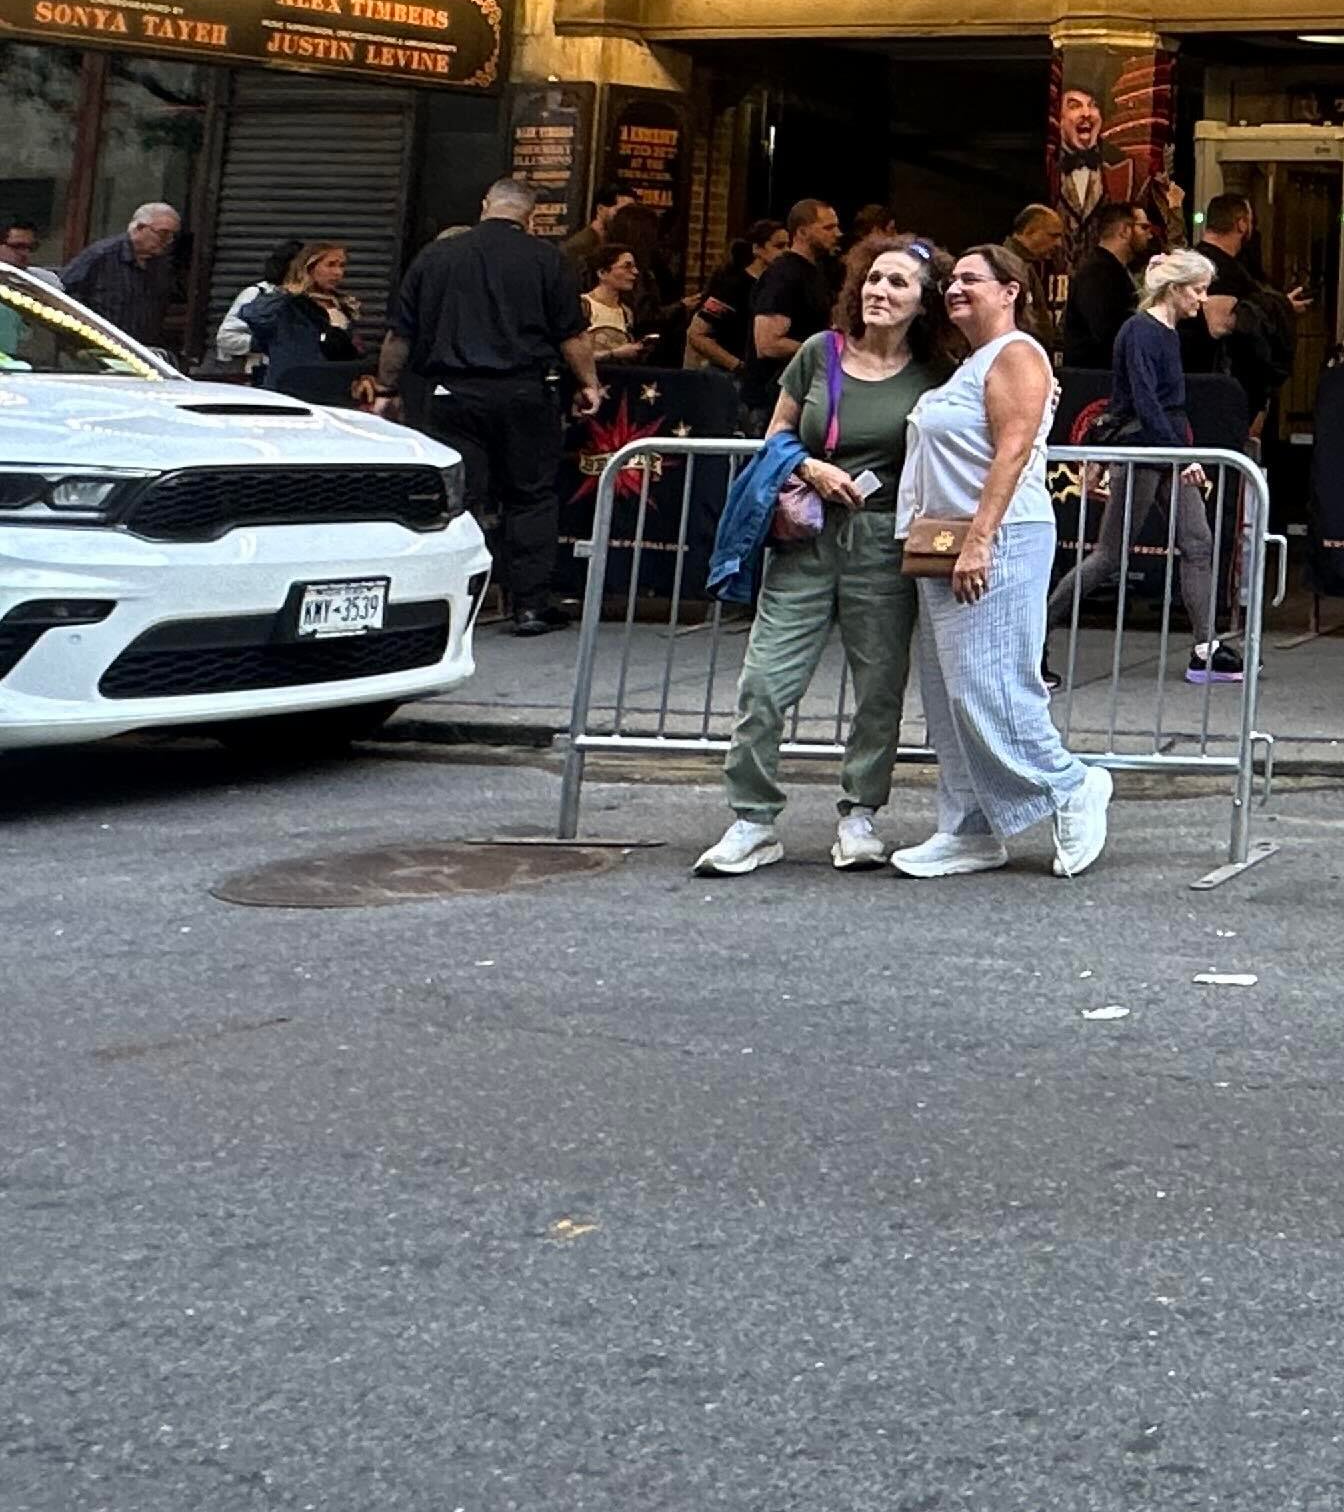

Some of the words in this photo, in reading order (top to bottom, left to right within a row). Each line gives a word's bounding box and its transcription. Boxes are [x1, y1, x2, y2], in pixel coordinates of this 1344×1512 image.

[35, 0, 128, 34] SONYA
[142, 14, 229, 46] TAYEH
[266, 31, 356, 61] JUSTIN
[365, 44, 450, 74] LEVINE
